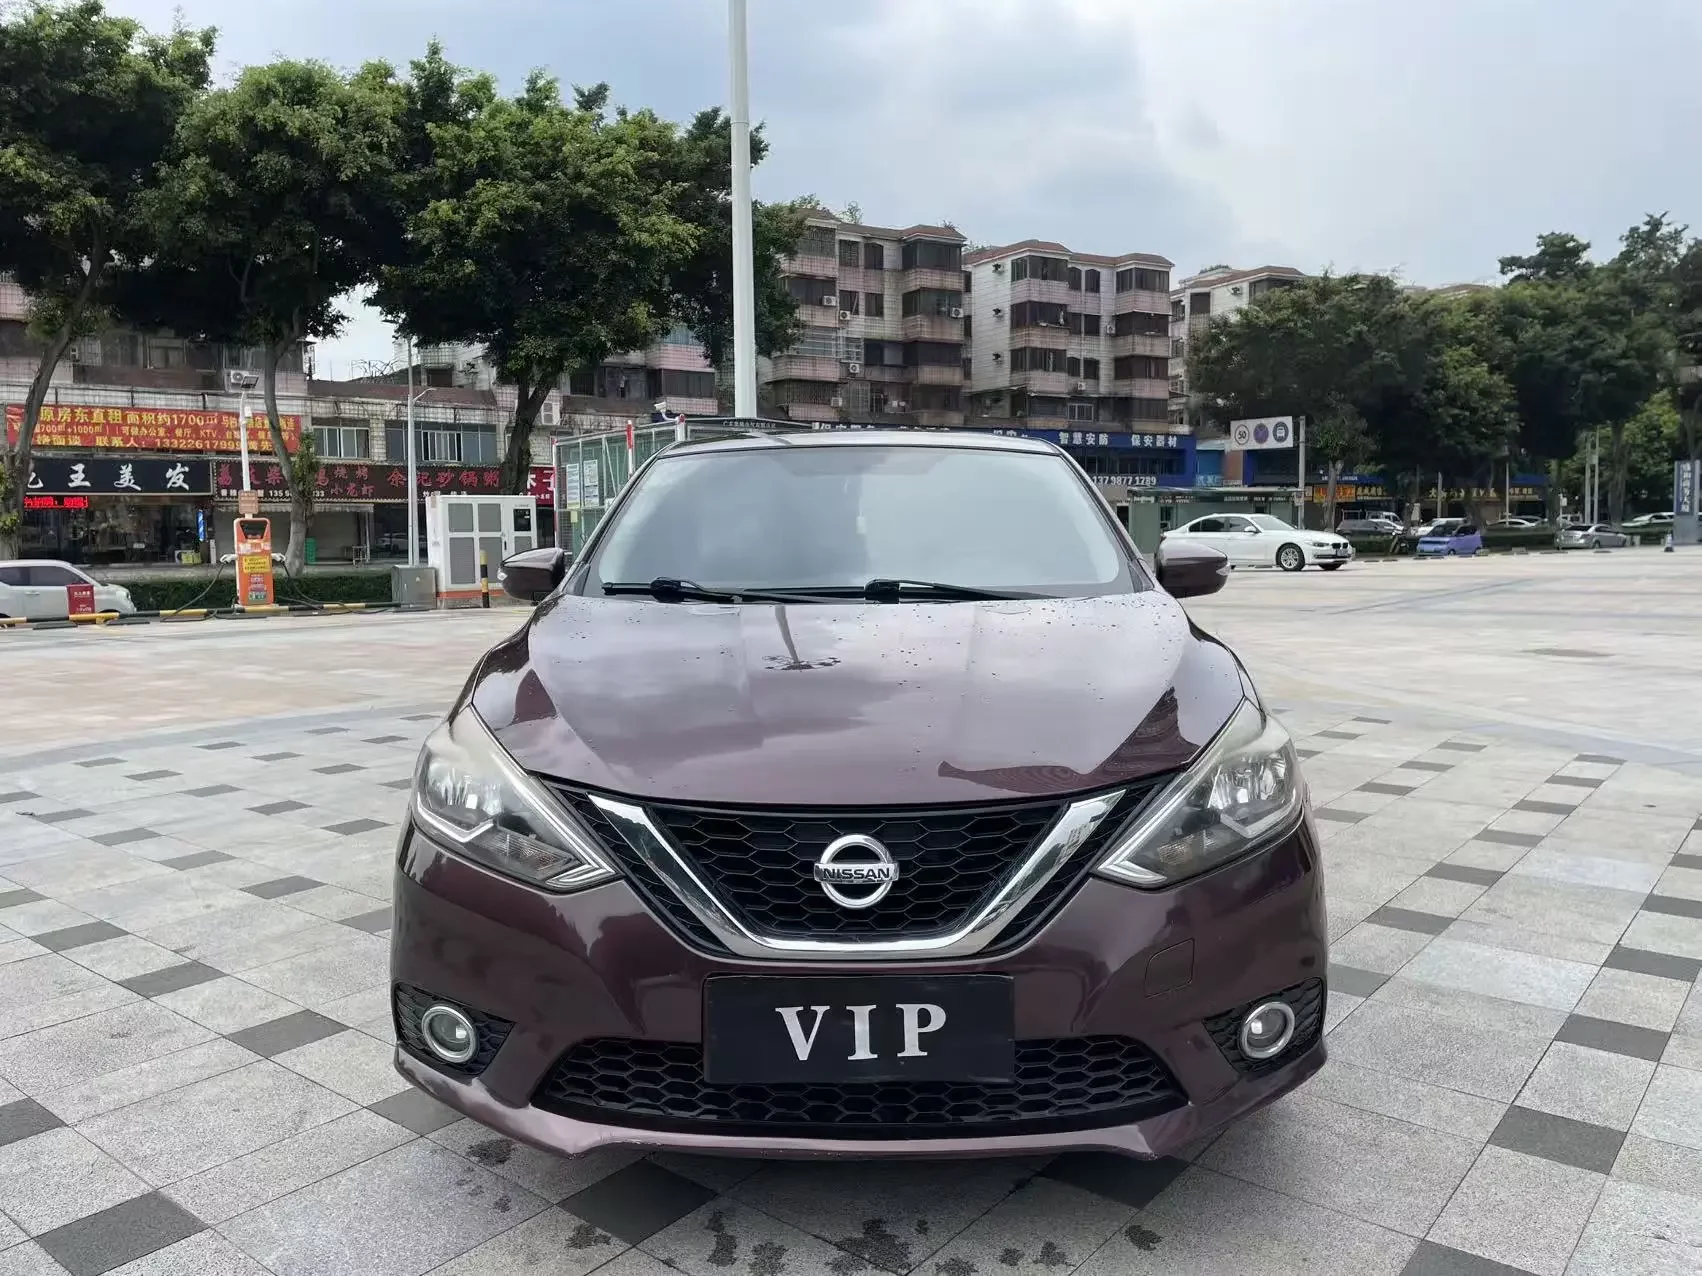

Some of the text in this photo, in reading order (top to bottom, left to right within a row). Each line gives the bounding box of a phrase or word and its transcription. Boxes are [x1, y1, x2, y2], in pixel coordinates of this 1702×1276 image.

[1059, 432, 1177, 447] 智慧安防 保安器材
[1110, 476, 1132, 486] 9877
[1134, 477, 1157, 486] 1289
[823, 868, 890, 880] NISSAN
[775, 1003, 947, 1061] VIP
